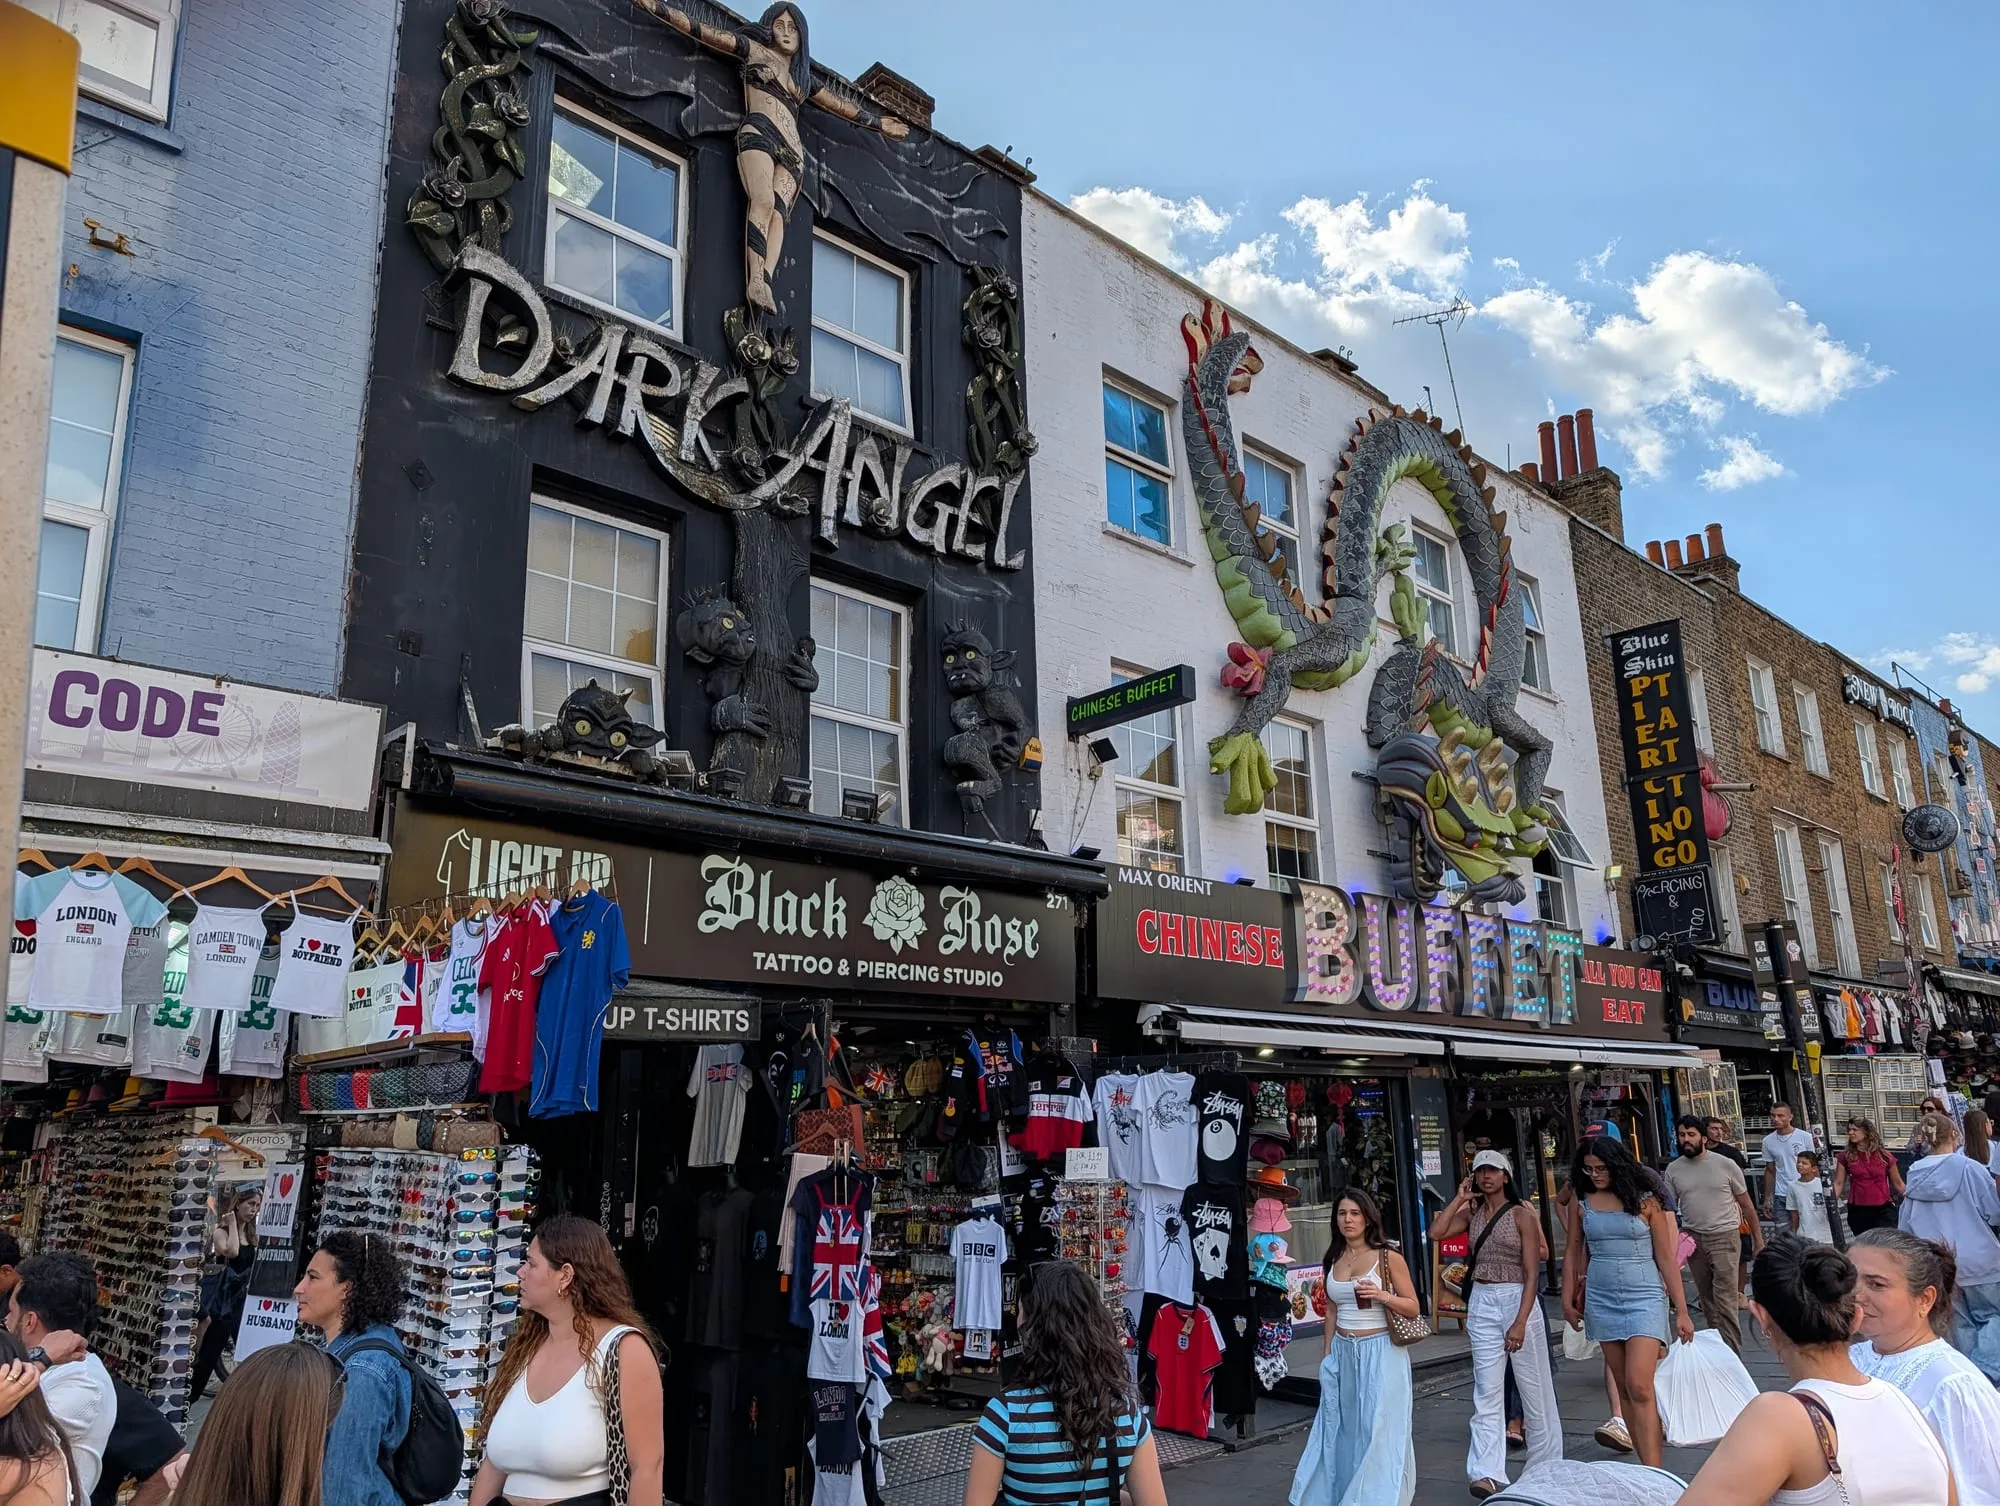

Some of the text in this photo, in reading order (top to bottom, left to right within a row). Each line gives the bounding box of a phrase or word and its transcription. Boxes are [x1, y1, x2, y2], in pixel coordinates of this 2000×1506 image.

[446, 242, 1028, 572] DARK ANGEL
[1619, 633, 1675, 679] Blue Skin
[1071, 673, 1177, 722] CHINESE BUFFET
[1850, 674, 1879, 706] NEW
[48, 670, 227, 738] CODE
[468, 837, 563, 900] LIGHT
[1118, 867, 1213, 896] MAX ORIENT
[697, 853, 1040, 966] Black Rose
[1046, 893, 1069, 911] 271
[1668, 894, 1680, 908] &
[56, 906, 118, 927] LONDON
[66, 935, 102, 945] ENGLAND
[196, 931, 263, 951] CAMDEN TOWN
[300, 937, 342, 956] I MY
[206, 953, 247, 964] LONDON
[292, 949, 343, 967] BOYFRIEND
[1136, 881, 1585, 1029] CHINESE BUFFET
[752, 951, 1004, 987] TATTOO & PIERCING STUDIO
[1580, 959, 1663, 992] ALL YOU CAN
[351, 988, 356, 1001] I
[602, 1006, 750, 1032] UP T-SHIRTS
[1602, 998, 1646, 1026] EAT
[1212, 1122, 1221, 1131] 8
[246, 1135, 286, 1146] PHOTOS
[268, 1172, 280, 1200] I
[257, 1249, 294, 1262] BOYFRIEND
[963, 1243, 996, 1257] BBC
[258, 1299, 289, 1314] I MY
[828, 1303, 834, 1320] I
[246, 1314, 294, 1331] HUSBAND
[819, 1321, 849, 1340] LONDON
